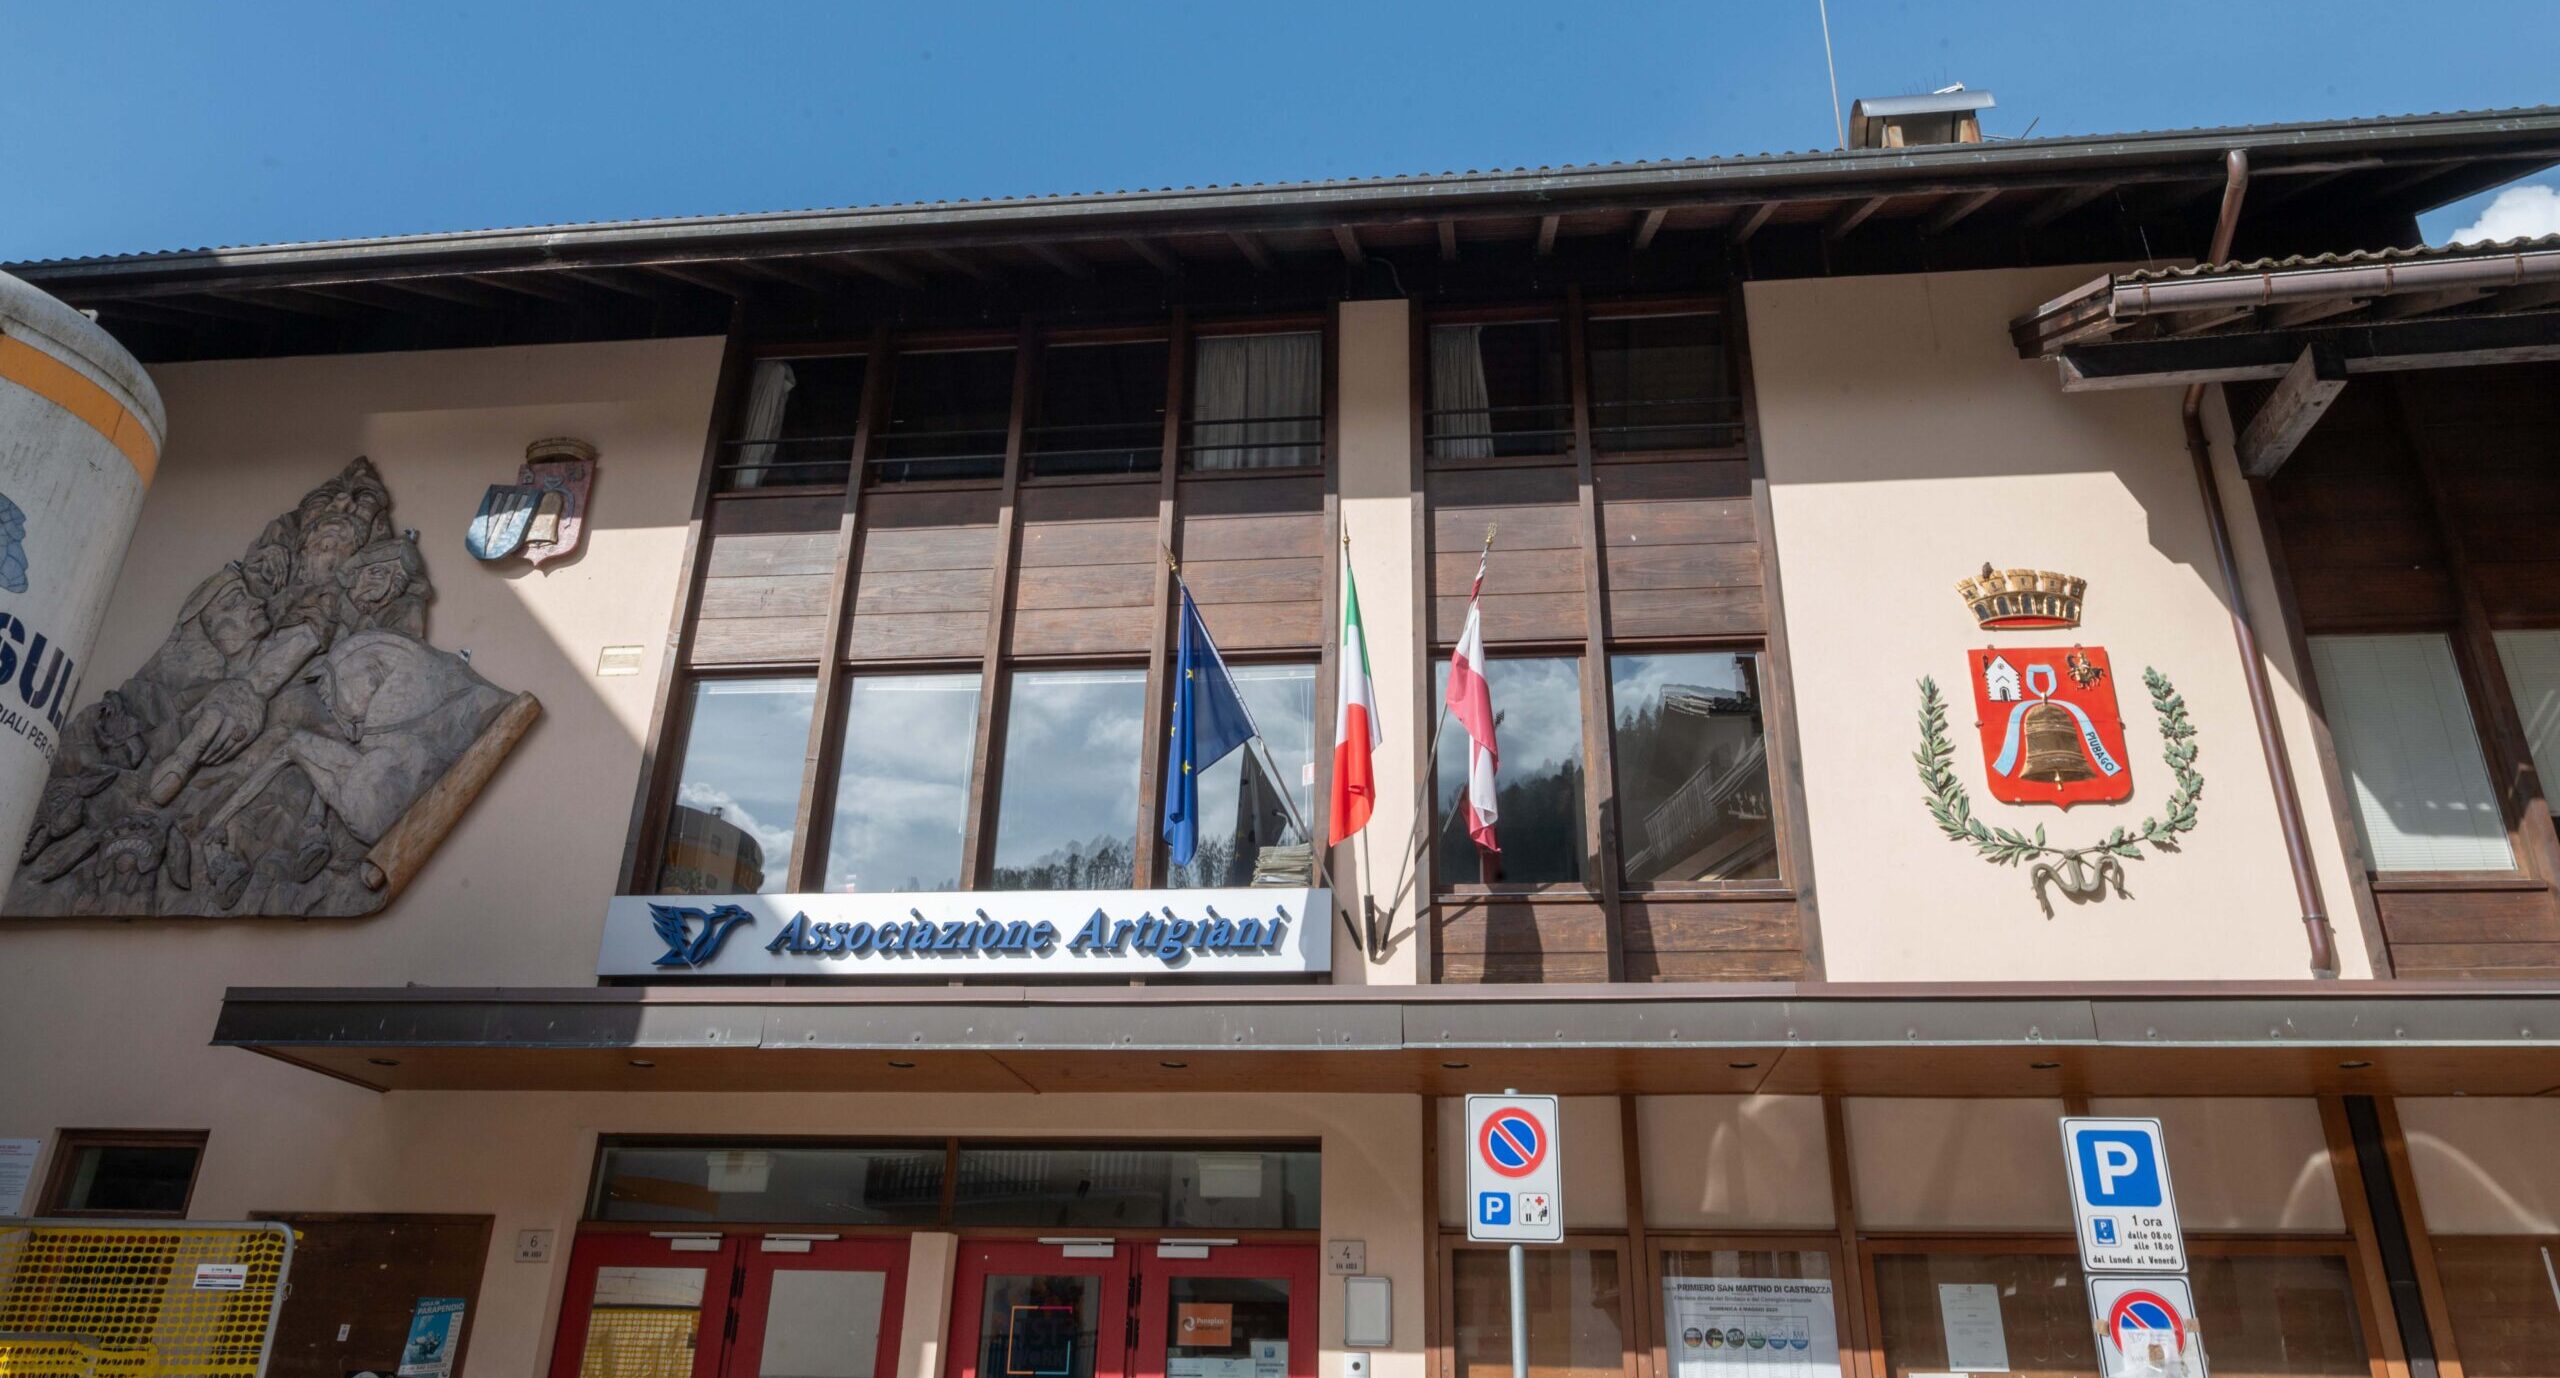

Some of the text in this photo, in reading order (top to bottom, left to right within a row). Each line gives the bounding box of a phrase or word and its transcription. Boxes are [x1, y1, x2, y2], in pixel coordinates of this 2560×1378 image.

[27, 726, 48, 753] PER
[2086, 731, 2114, 772] PIUBAGO
[765, 905, 1289, 960] Associazione Artigiani
[2094, 1141, 2138, 1195] P
[1486, 1196, 1504, 1221] P
[2132, 1214, 2163, 1227] 1 ora
[530, 1235, 538, 1248] 6
[2128, 1231, 2173, 1240] dalle 08.00
[1342, 1246, 1350, 1259] 4
[2134, 1242, 2174, 1251] alle 18.00
[2093, 1255, 2105, 1263] dal
[2137, 1256, 2145, 1264] al
[1677, 1284, 1715, 1292] PRIMIERO
[1717, 1284, 1734, 1292] SAN
[1736, 1284, 1772, 1293] MARTINO
[1774, 1285, 1782, 1293] DI
[1783, 1285, 1831, 1294] CASTROZZA
[417, 1302, 465, 1315] PARAPENDIO
